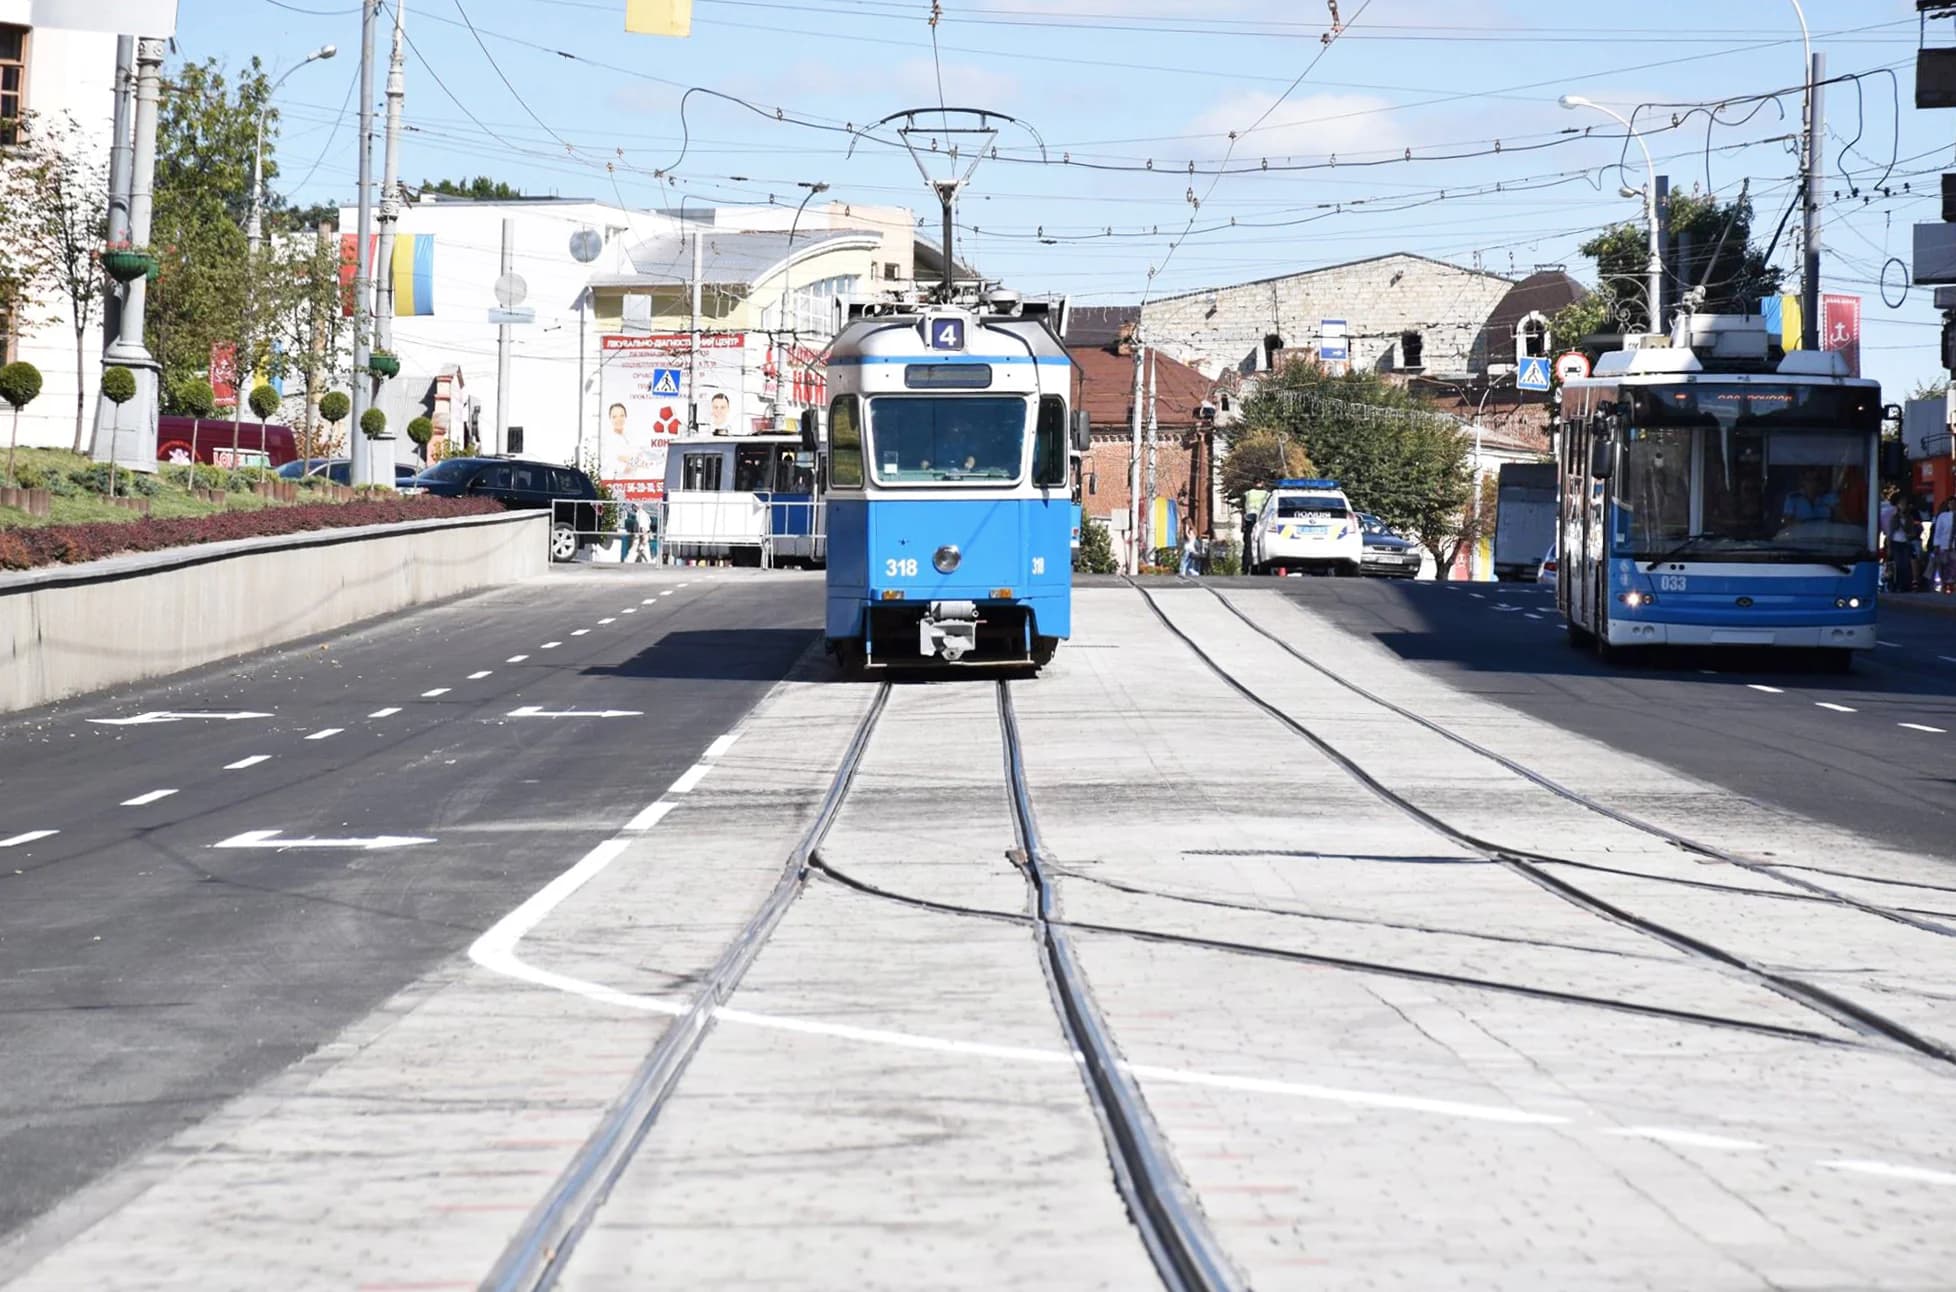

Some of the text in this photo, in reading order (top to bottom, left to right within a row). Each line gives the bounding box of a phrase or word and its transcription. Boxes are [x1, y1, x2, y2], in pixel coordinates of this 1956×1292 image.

[939, 324, 957, 347] 4
[886, 559, 917, 576] 318
[1031, 557, 1044, 575] 318
[1661, 575, 1687, 591] 033
